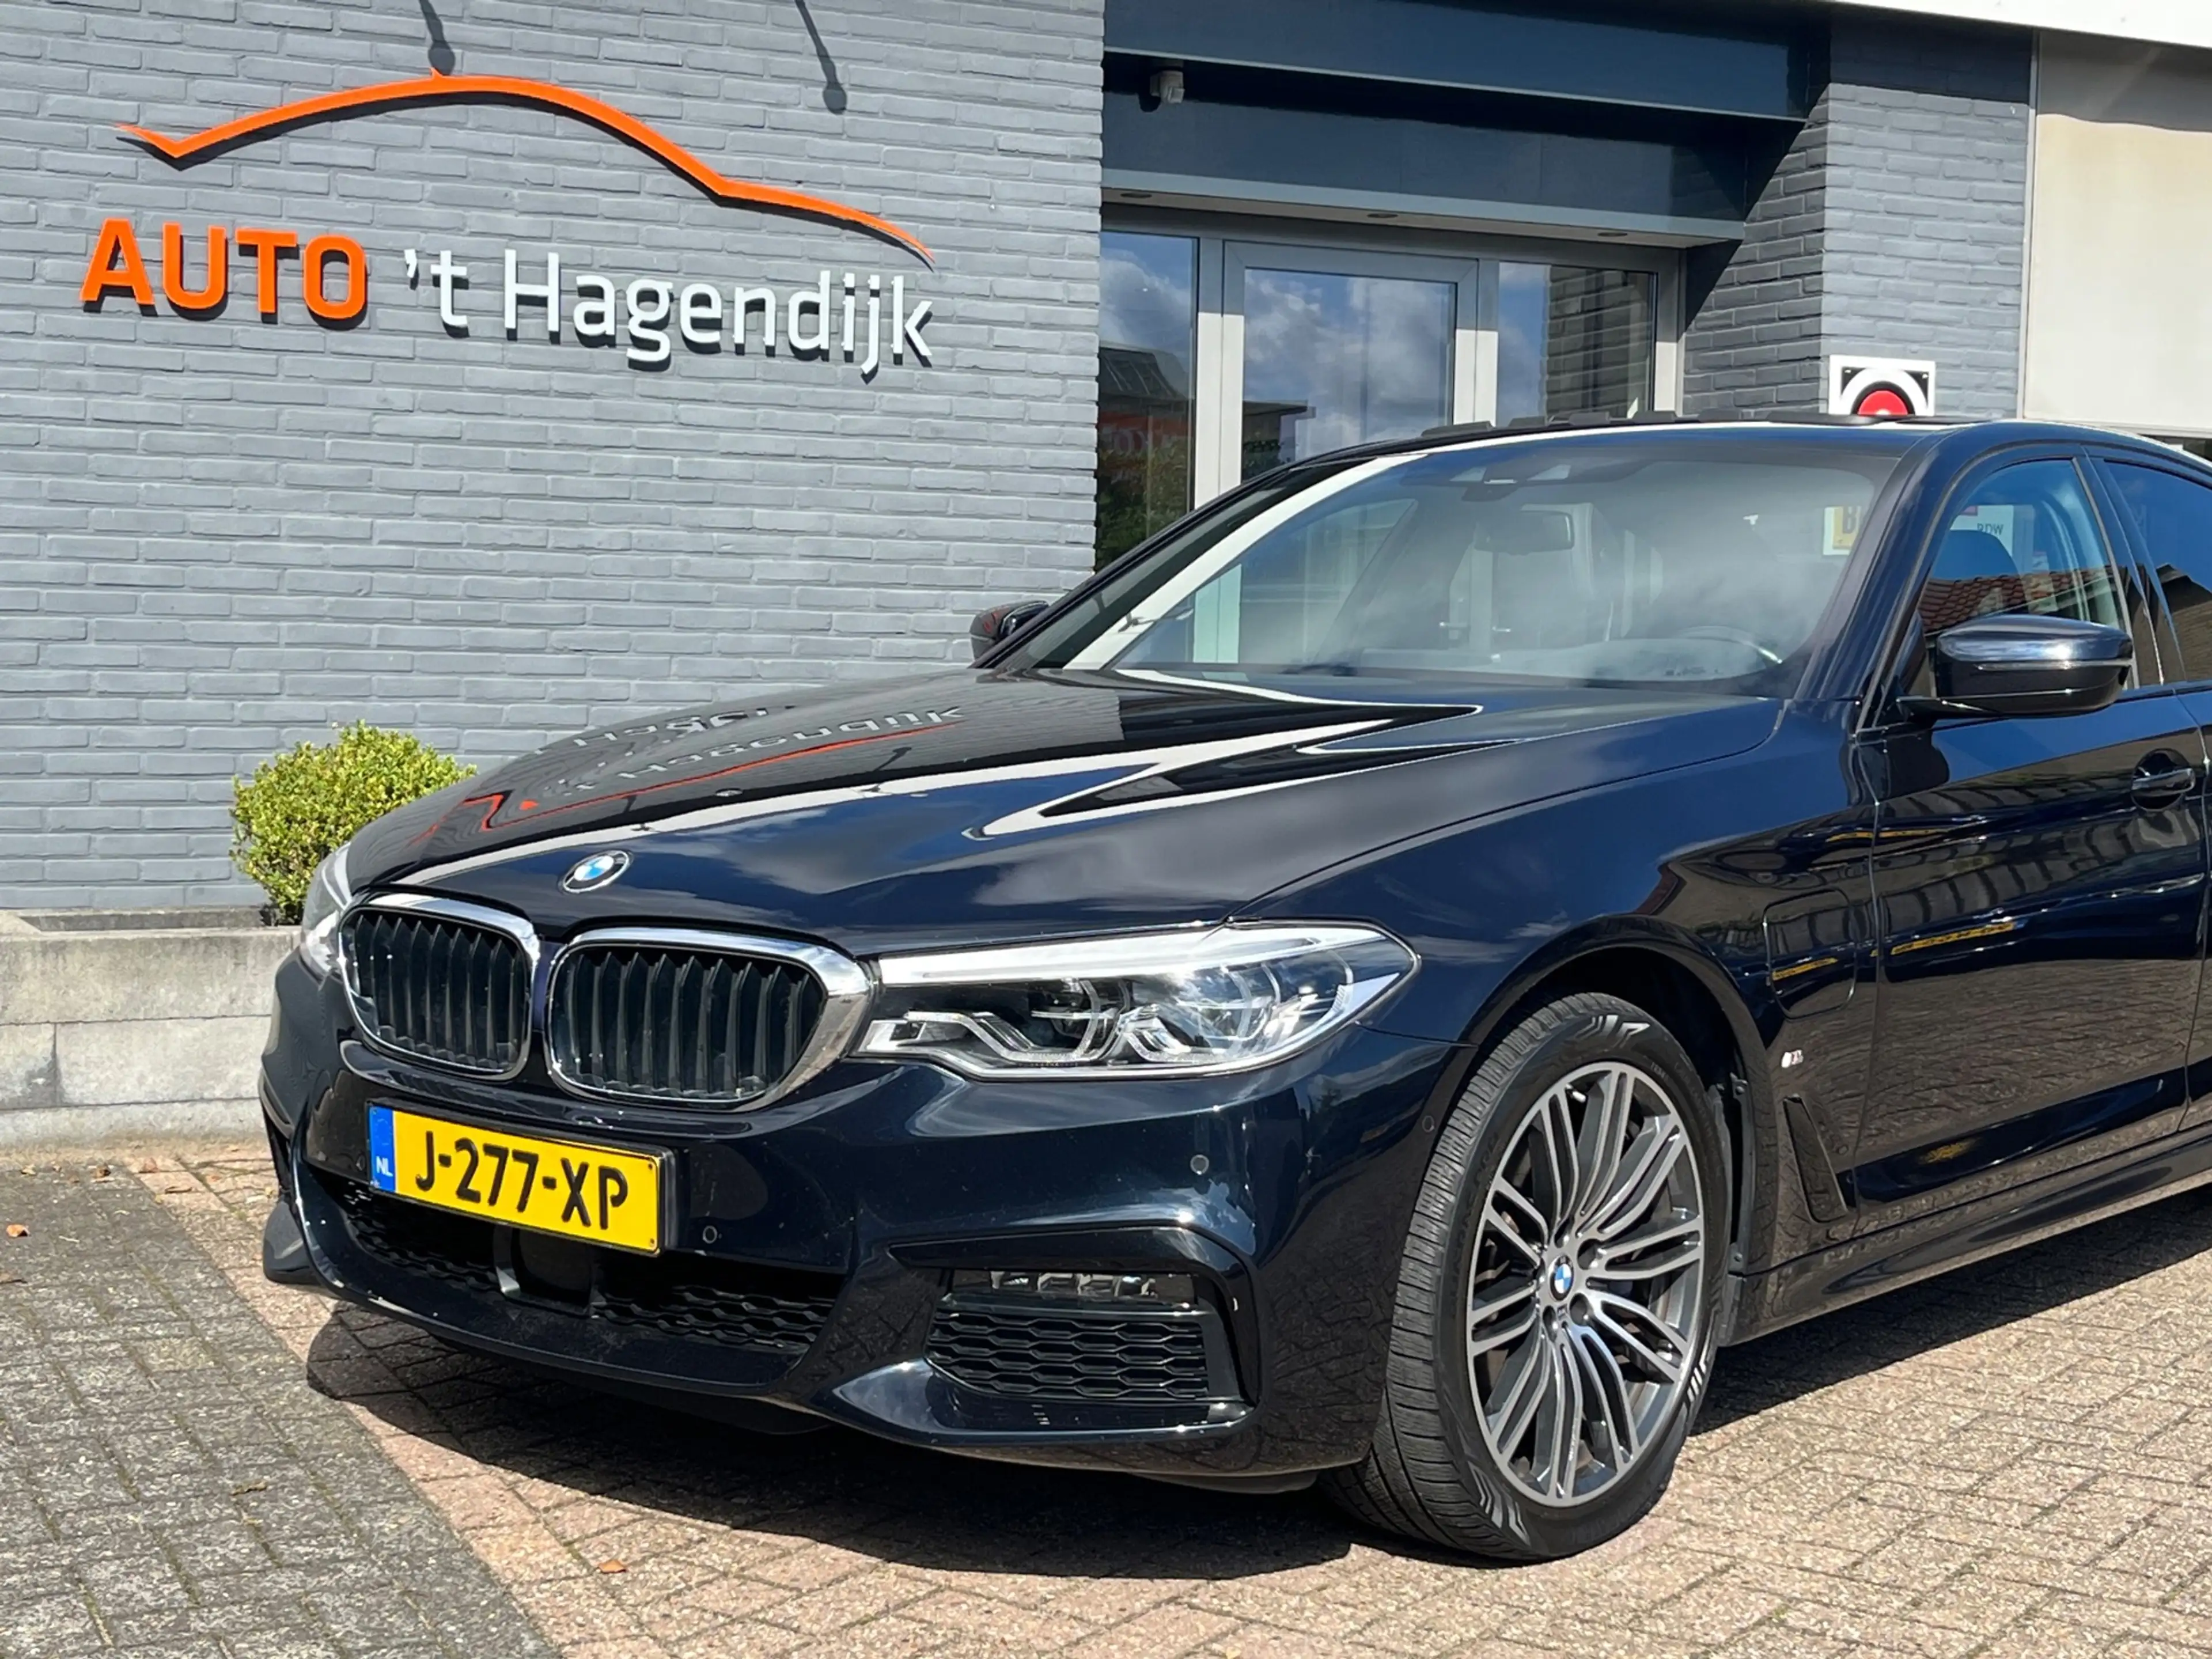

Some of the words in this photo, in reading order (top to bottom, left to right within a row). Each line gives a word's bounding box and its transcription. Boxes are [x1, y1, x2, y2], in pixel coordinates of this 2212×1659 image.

[79, 218, 367, 320] AUTO
[505, 248, 933, 374] Hagendijk
[376, 1156, 393, 1177] NL
[415, 1131, 628, 1230] J-277-XP
